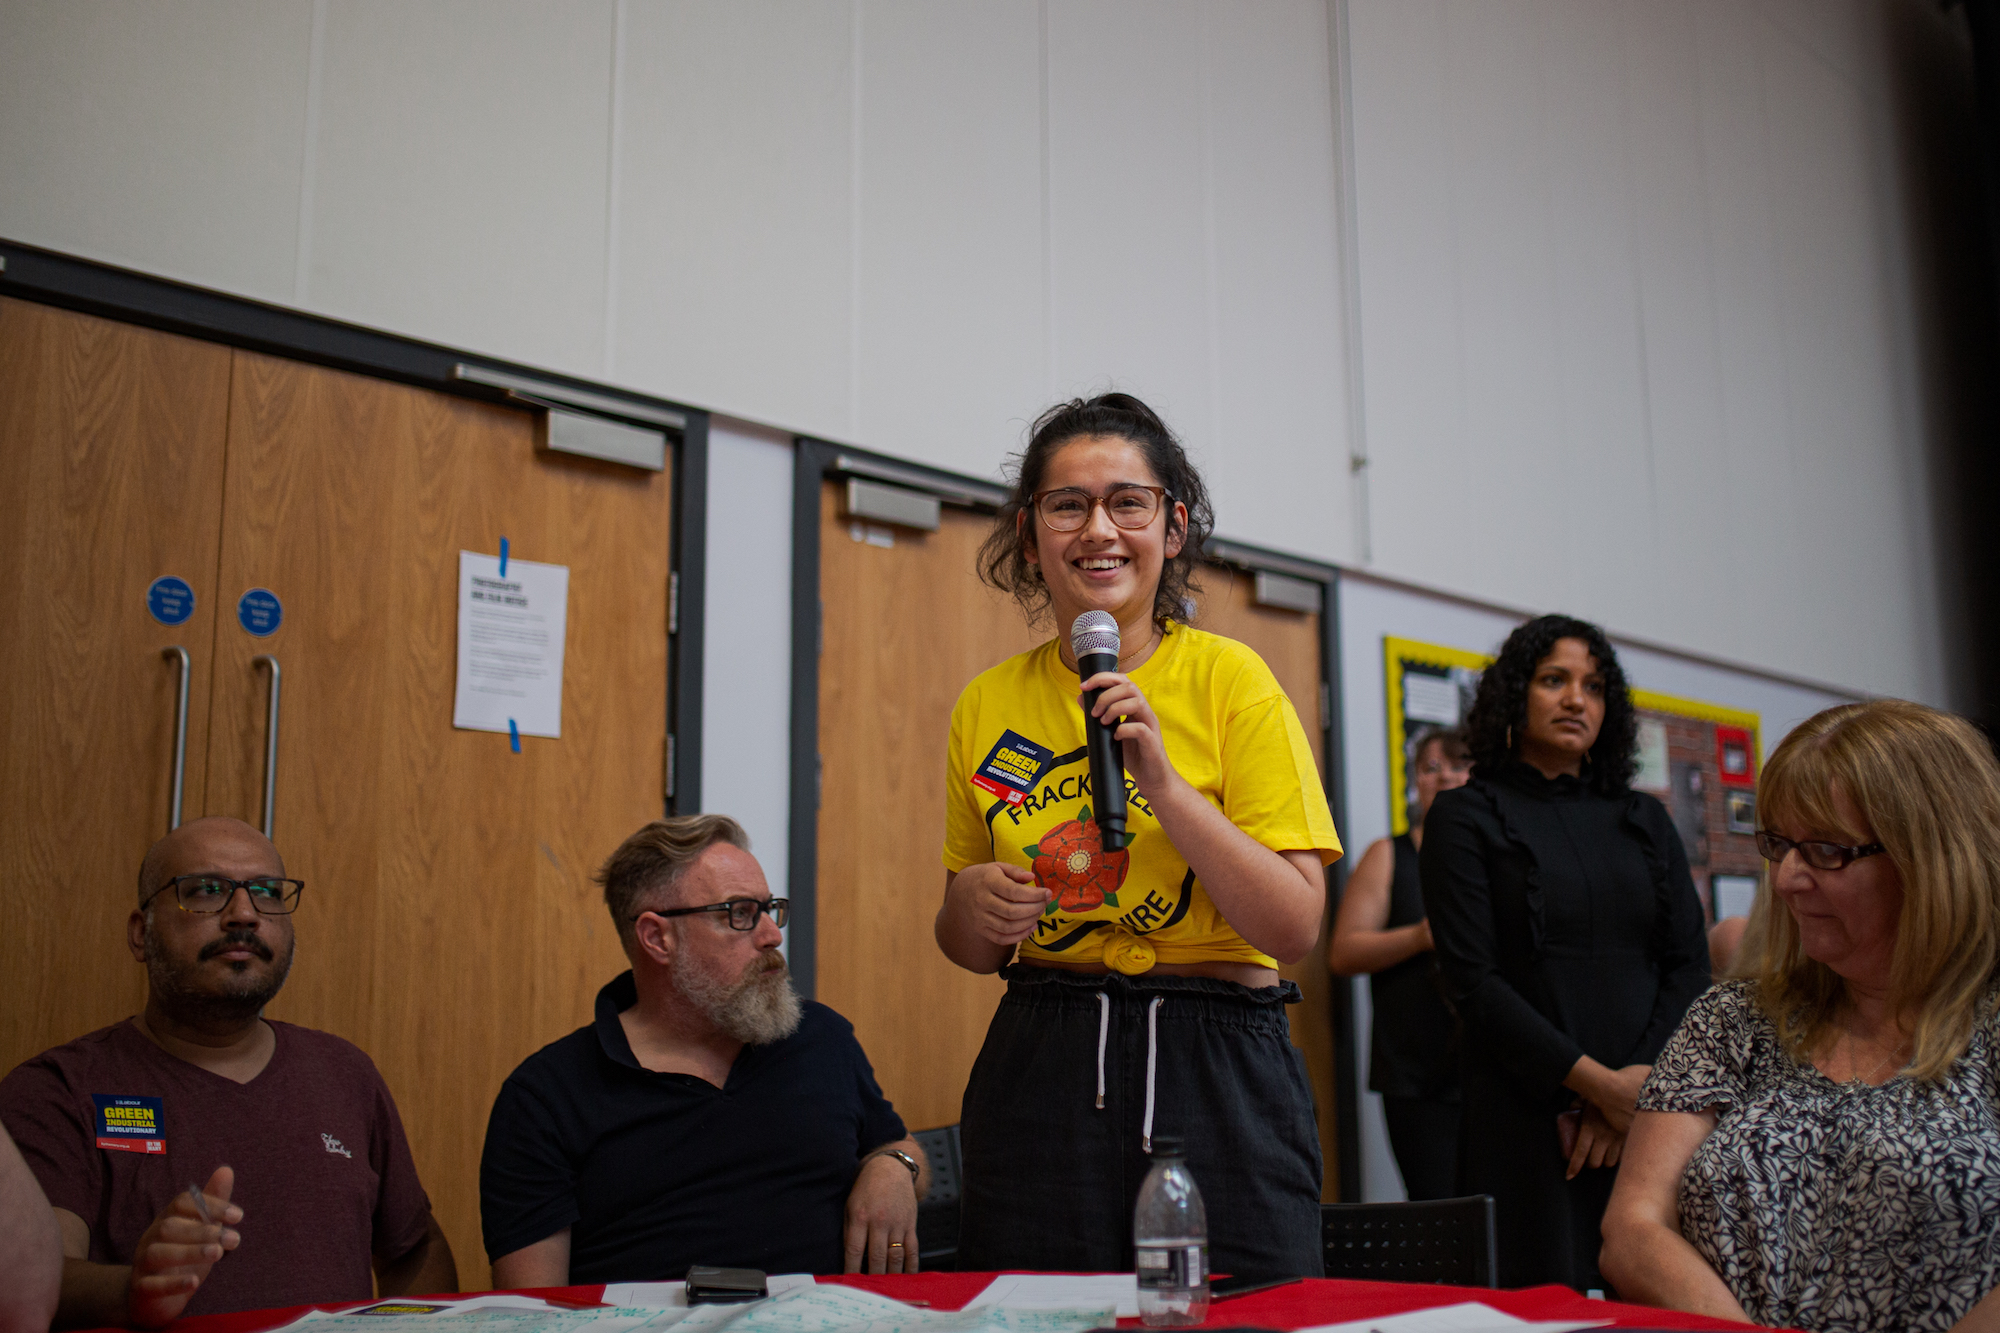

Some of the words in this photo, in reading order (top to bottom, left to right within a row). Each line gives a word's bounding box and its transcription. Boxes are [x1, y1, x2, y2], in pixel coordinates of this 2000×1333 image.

[991, 758, 1032, 781] INDUSTRIAL
[996, 747, 1041, 774] GREEN
[986, 766, 1029, 786] REVOLUTIONARY
[1005, 774, 1092, 825] FRACK
[104, 1107, 155, 1120] GREEN
[106, 1119, 156, 1127] INDUSTRIAL
[106, 1126, 156, 1134] REVOLUTIONARY
